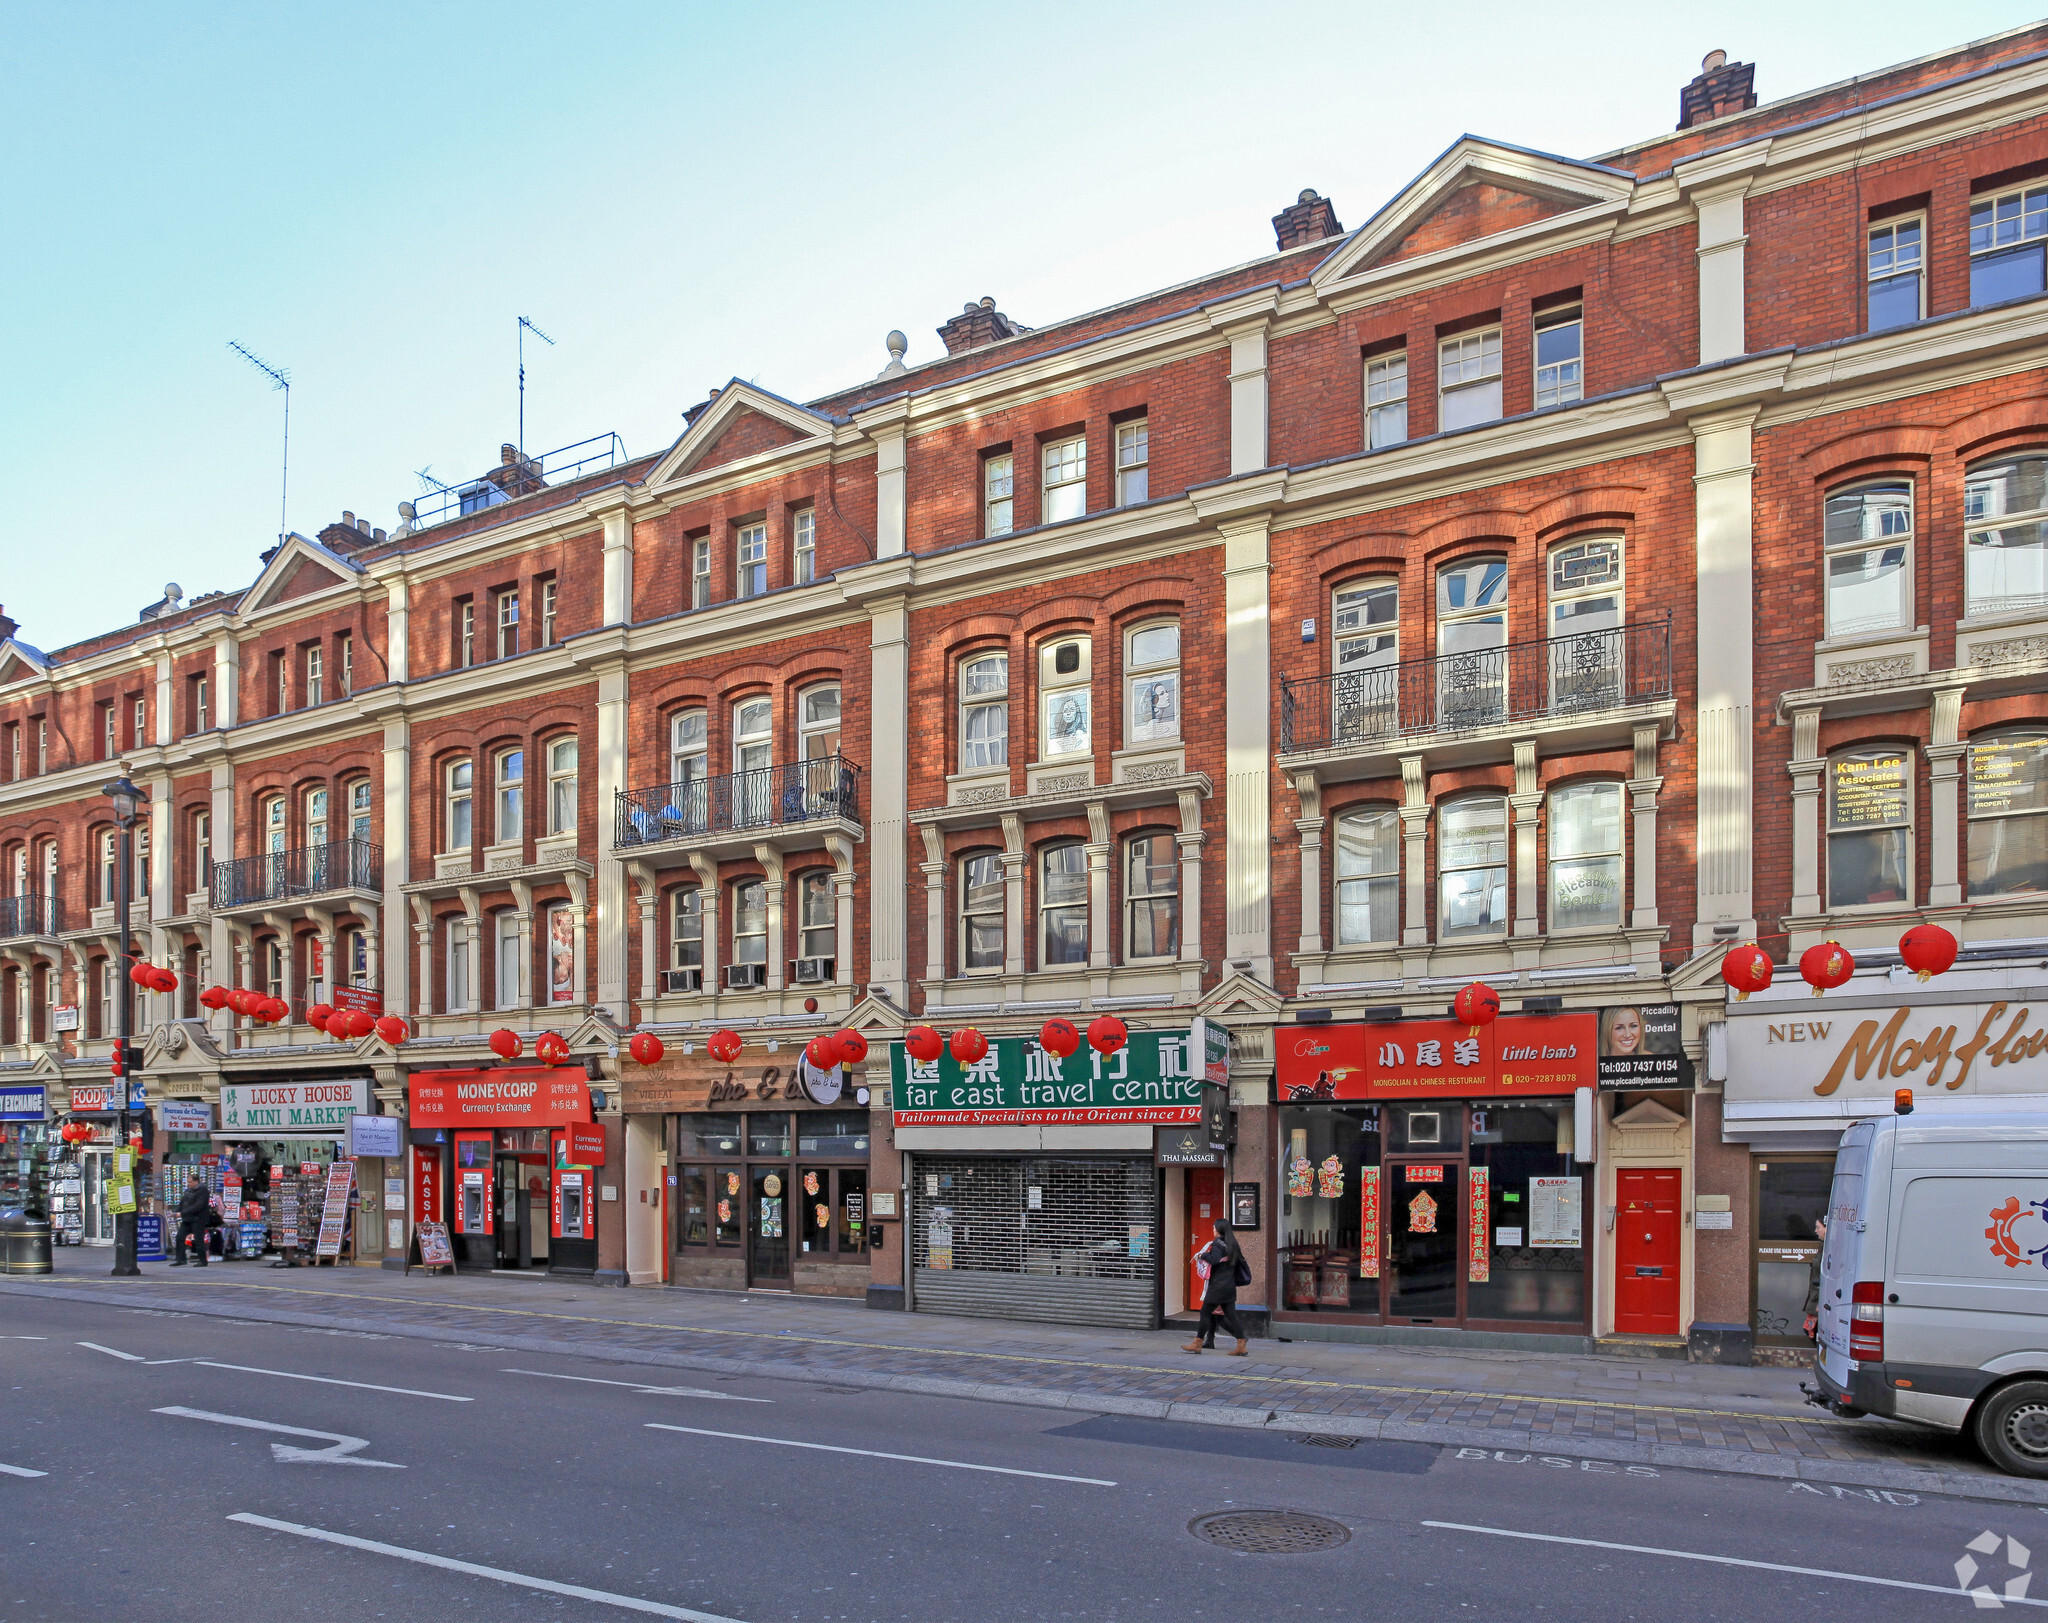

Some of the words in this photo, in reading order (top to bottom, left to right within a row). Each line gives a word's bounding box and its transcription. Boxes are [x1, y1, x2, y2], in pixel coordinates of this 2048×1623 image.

[1974, 744, 2009, 753] BUSINESS
[1837, 762, 1868, 774] Kam
[1874, 759, 1901, 770] Lee
[1975, 761, 2025, 772] ACCOUNTANCY
[1838, 772, 1900, 785] Associates
[1975, 772, 2009, 780] TAXATION
[1837, 785, 1870, 794] CHARTERED
[1975, 780, 2022, 789] MANAGEMENT
[1837, 792, 1878, 800] ACCOUNTANTS
[1975, 791, 2011, 799] FINANCING
[1975, 800, 2011, 808] PROPERTY
[1554, 870, 1617, 891] Piccadilly
[1560, 889, 1612, 908] Dental
[336, 990, 359, 999] STUDENT
[361, 994, 378, 1002] TRAVEL
[1641, 1005, 1679, 1016] Piccadilly
[1645, 1022, 1676, 1033] Dental
[1767, 1021, 1832, 1044] NEW
[1379, 1038, 1481, 1067] 小尾羊
[1502, 1045, 1537, 1061] Little
[1541, 1043, 1577, 1059] lamb
[1633, 1061, 1654, 1072] 7437
[1656, 1060, 1678, 1071] 0154
[1373, 1078, 1411, 1087] MONGOLIAN
[1420, 1077, 1446, 1086] CHINESE
[1448, 1076, 1487, 1086] RESTURANT
[1600, 1076, 1678, 1086] www.piccadillydental.com
[458, 1082, 538, 1099] MONEYCORP
[706, 1072, 748, 1109] pho
[756, 1066, 780, 1100] &
[905, 1085, 937, 1107] far
[951, 1084, 1005, 1107] east
[1020, 1079, 1094, 1103] travel
[1112, 1077, 1201, 1101] centre
[73, 1089, 101, 1104] FOOD
[251, 1088, 298, 1105] LUCKY
[304, 1085, 352, 1103] HOUSE
[5, 1094, 43, 1112] EXCHANGE
[462, 1103, 495, 1114] Currency
[497, 1102, 533, 1112] Exchange
[191, 1108, 210, 1116] Change
[247, 1109, 282, 1126] MINI
[900, 1111, 968, 1123] Tailormade
[972, 1109, 1042, 1123] Specialists
[1046, 1111, 1058, 1121] to
[1061, 1110, 1083, 1121] the
[1087, 1108, 1133, 1121] Orient
[1134, 1108, 1175, 1119] since
[575, 1135, 602, 1144] Currency
[574, 1144, 603, 1152] Exchange
[1162, 1154, 1180, 1162] THAI
[1182, 1154, 1215, 1162] MASSAGE
[1455, 1447, 1661, 1478] BUSES
[1786, 1481, 1922, 1506] AND
